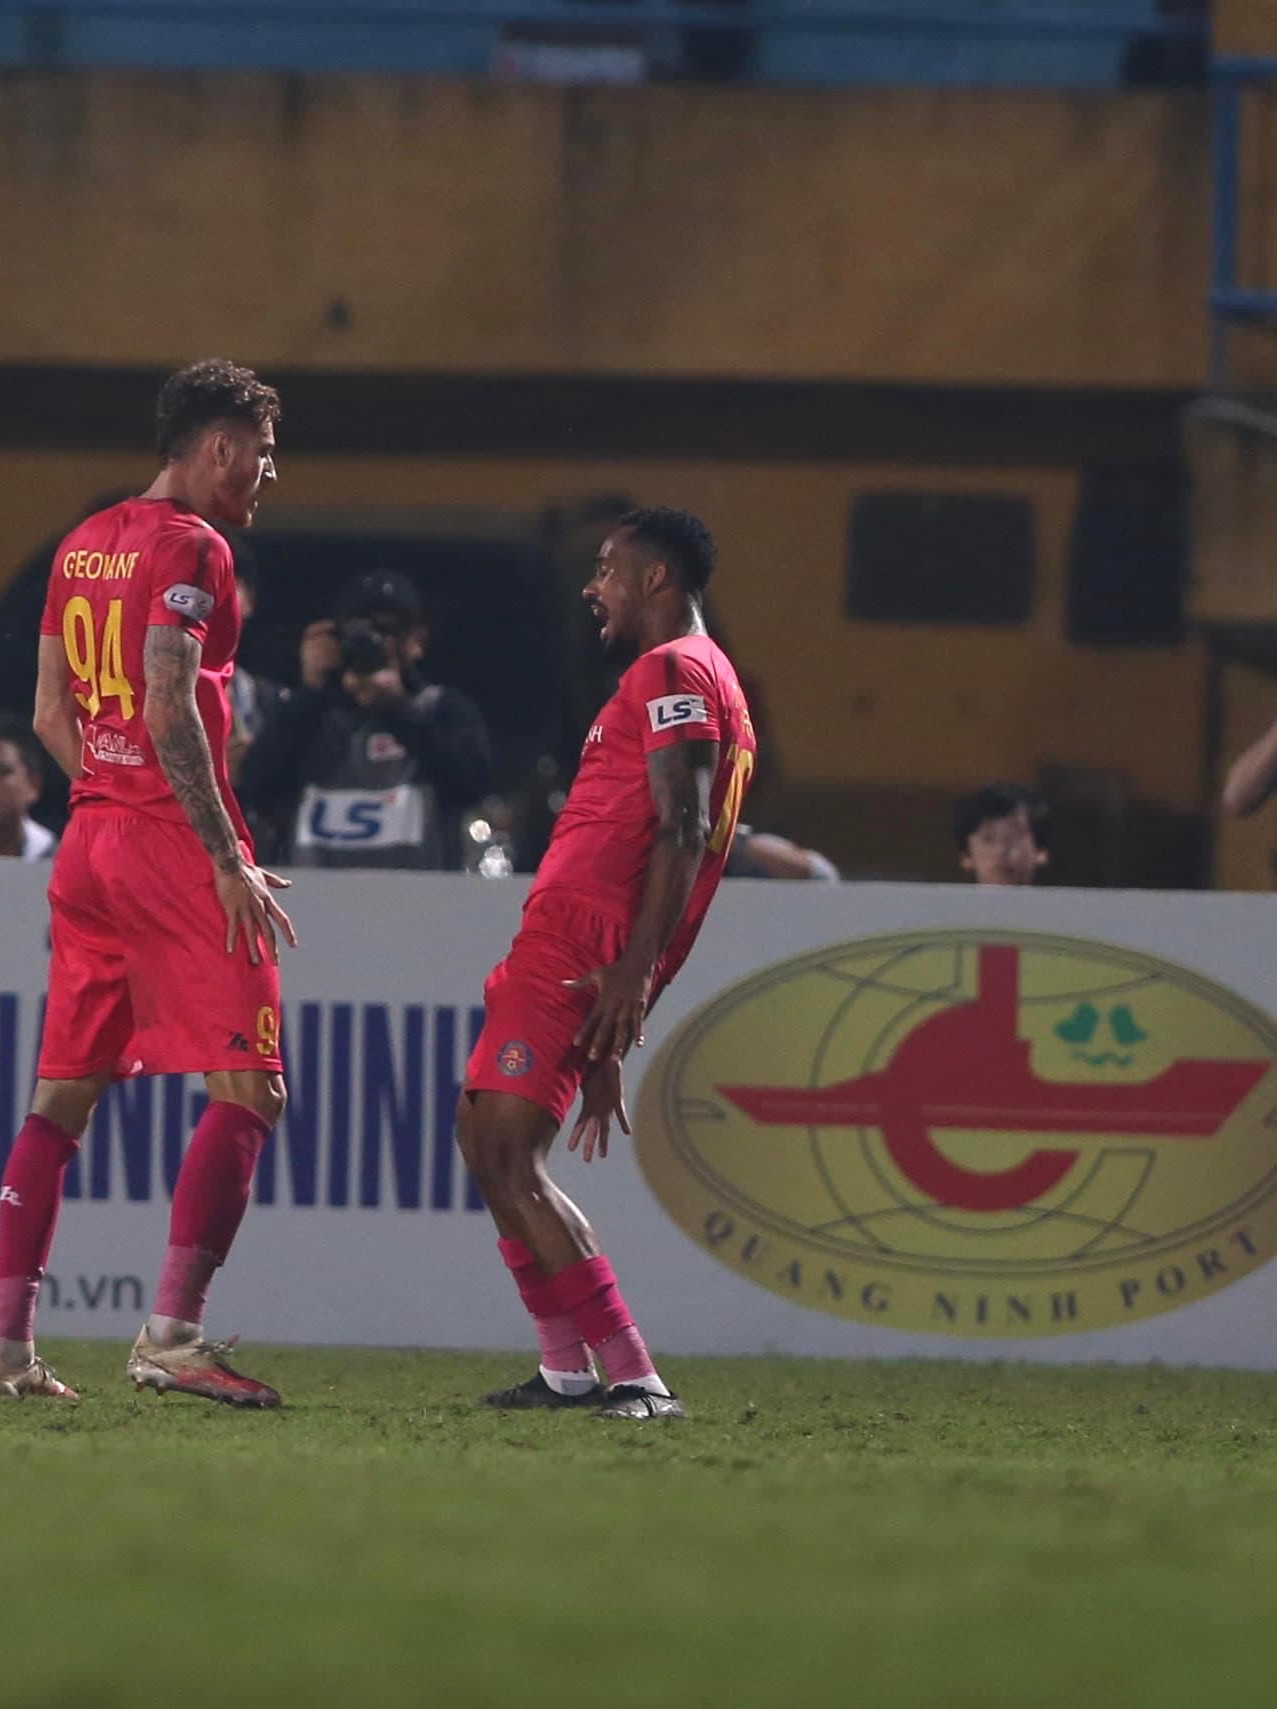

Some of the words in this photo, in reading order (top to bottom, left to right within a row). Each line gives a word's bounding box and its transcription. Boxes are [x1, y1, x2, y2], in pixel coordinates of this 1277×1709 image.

[169, 592, 195, 605] LS
[62, 596, 135, 721] 94
[657, 700, 693, 725] LS
[309, 798, 386, 842] LS
[704, 1210, 894, 1313] QUANG
[932, 1290, 1078, 1325] NINH
[1120, 1230, 1259, 1309] PORT
